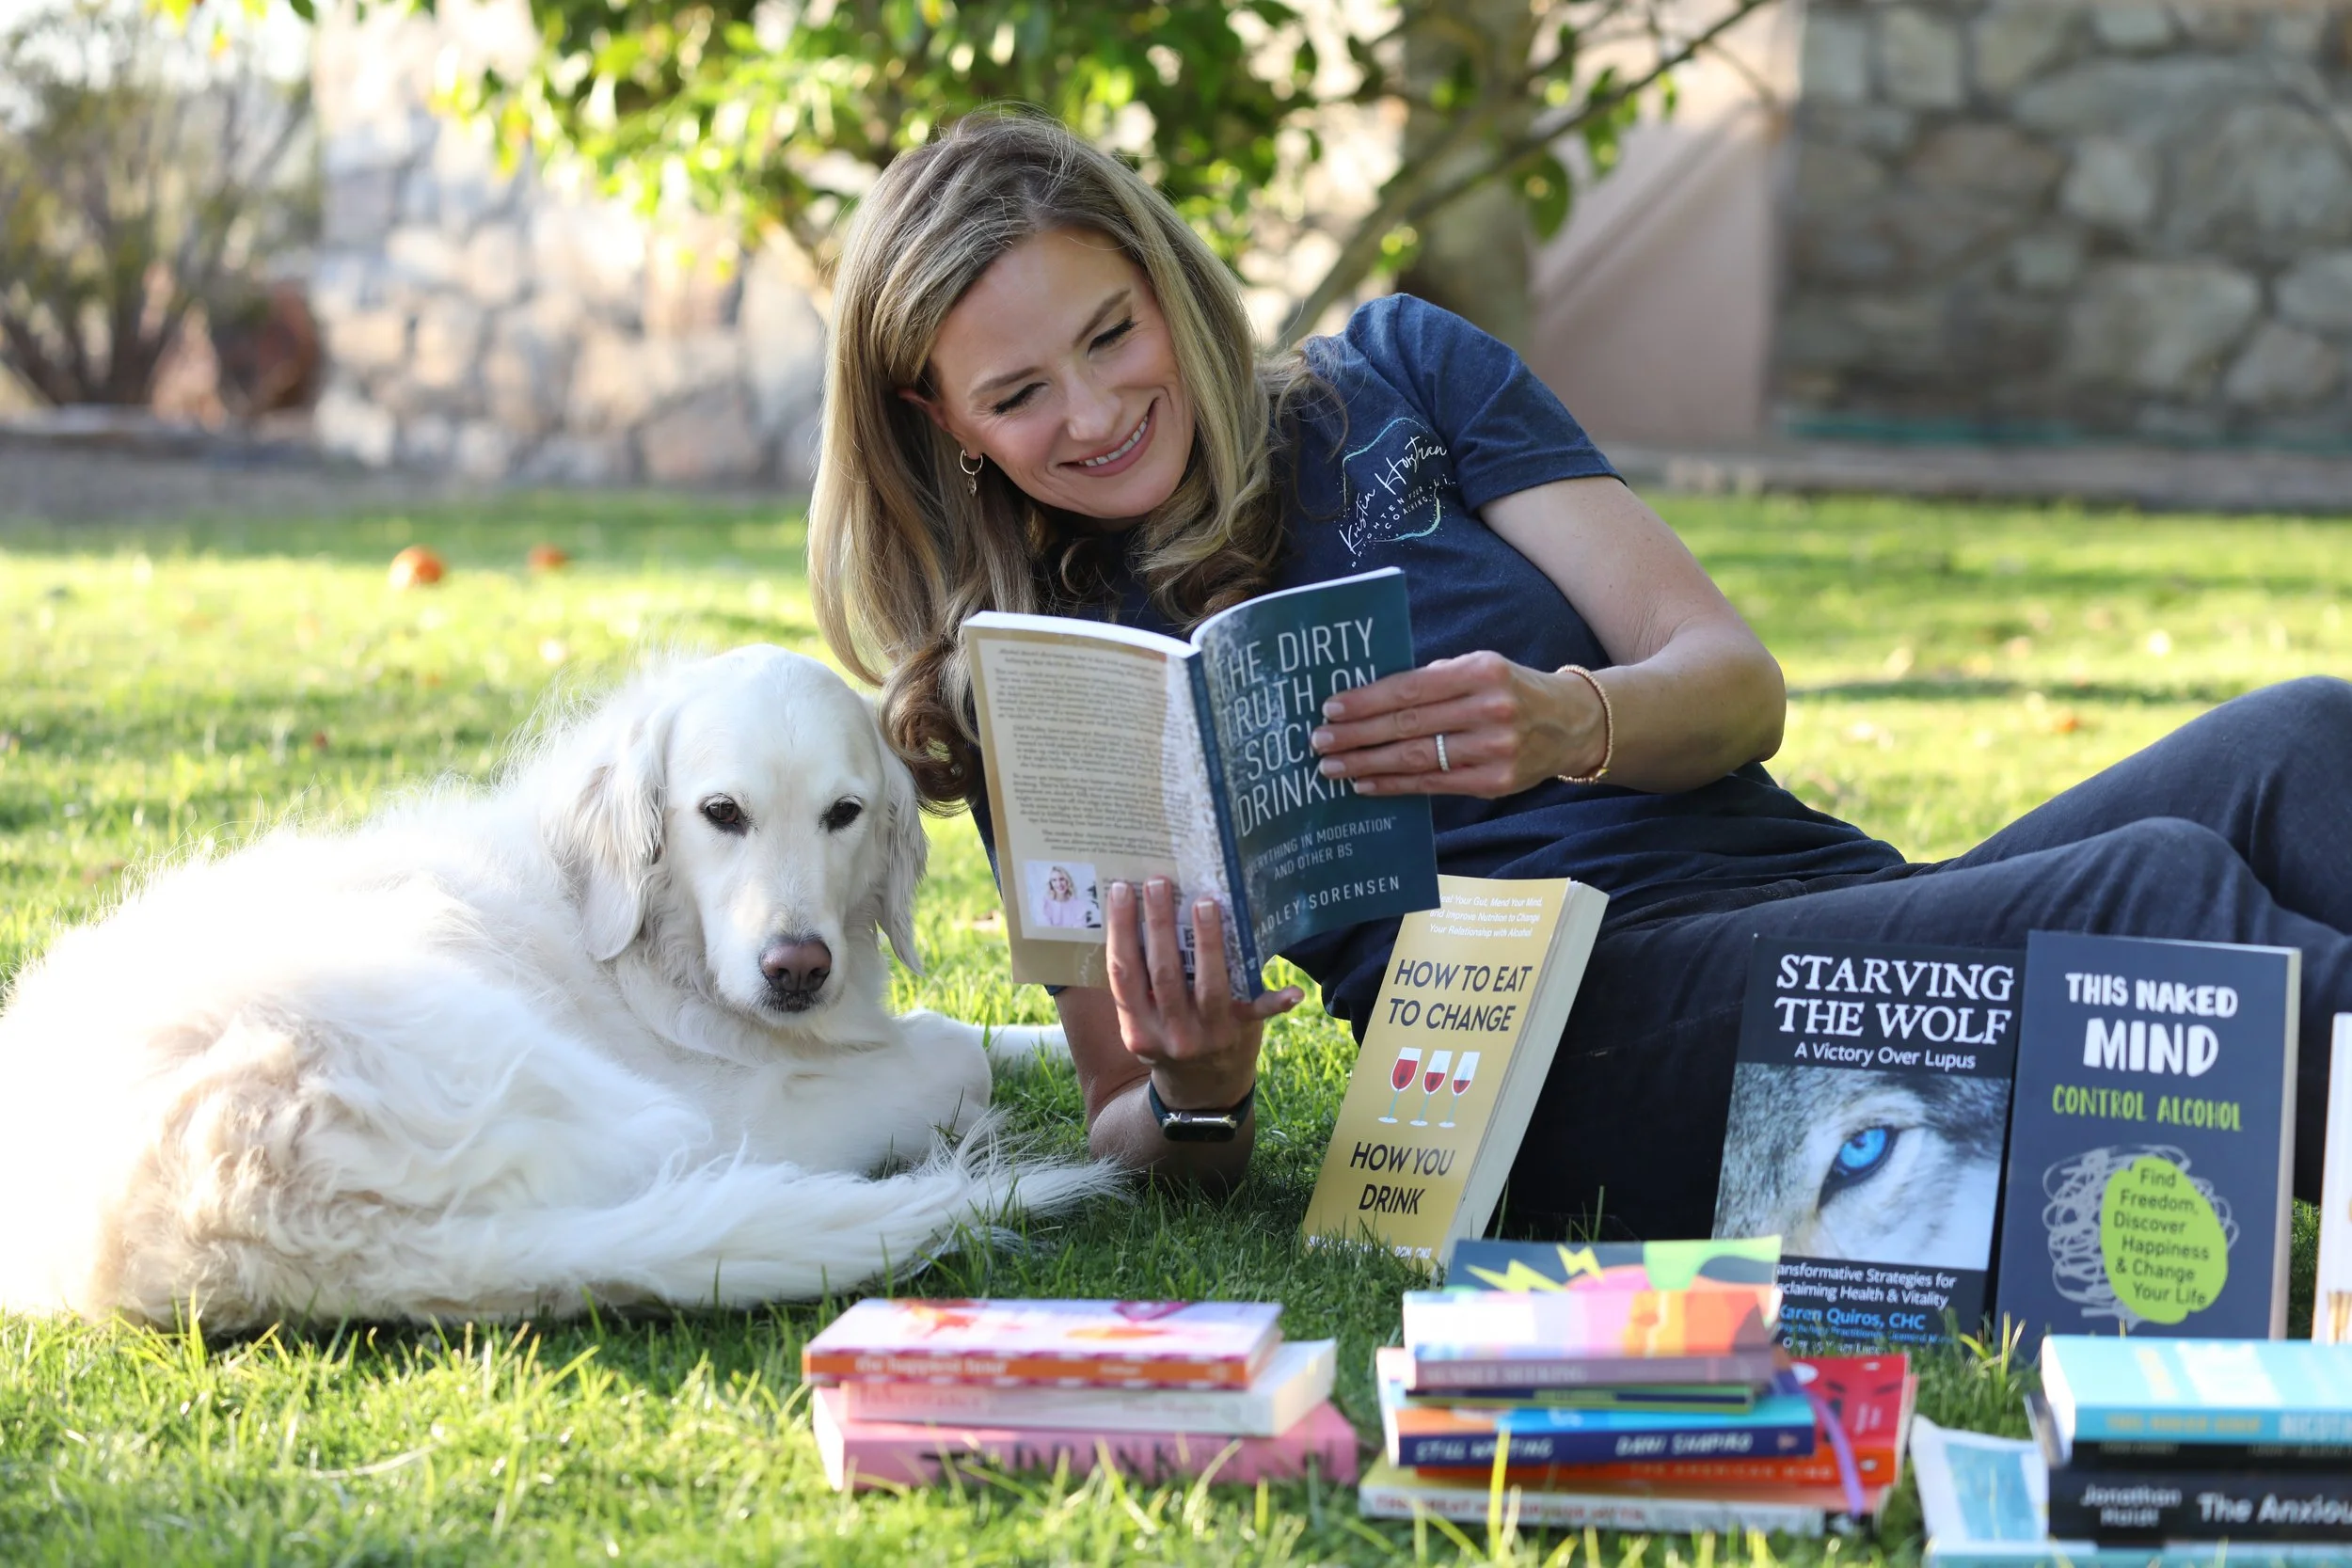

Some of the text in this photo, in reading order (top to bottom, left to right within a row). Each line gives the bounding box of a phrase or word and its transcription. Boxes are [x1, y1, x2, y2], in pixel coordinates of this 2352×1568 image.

[1338, 488, 1375, 555] Kristin
[1216, 641, 1263, 696] THE
[1278, 617, 1373, 673] DIRTY
[1223, 673, 1315, 747] TRUTH
[1244, 715, 1328, 782] SOCI
[1301, 832, 1313, 848] IN
[1274, 843, 1354, 881] AND OTHER BS
[1309, 876, 1400, 910] SORENSEN
[1455, 895, 1472, 905] Your
[1490, 896, 1511, 908] Mend
[1511, 897, 1525, 907] Your
[1429, 924, 1534, 939] Your Relationship with Alcohol
[1430, 909, 1540, 925] and Improve Nutrition to Change
[1393, 958, 1533, 992] HOW TO EAT
[1775, 953, 2014, 1002] STARVING
[2065, 973, 2238, 1018] THIS NAKED
[1388, 998, 1517, 1032] TO CHANGE
[1774, 996, 2012, 1045] THE WOLF
[1794, 1041, 1976, 1072] A Victory Over Lupus
[2083, 1017, 2219, 1077] MIND
[2052, 1084, 2243, 1132] CONTROL ALCOHOL
[1349, 1141, 1456, 1176] HOW YOU
[2139, 1167, 2177, 1188] Find
[1359, 1183, 1426, 1215] DRINK
[2120, 1189, 2199, 1215] Freedom,
[2113, 1210, 2186, 1234] Discover
[2122, 1235, 2210, 1262] Happiness
[1776, 1261, 1958, 1290] ansformative Strategies for
[2115, 1257, 2196, 1283] & Change
[1776, 1280, 1949, 1310] claiming Health & Vitality
[2133, 1281, 2207, 1305] Your Life
[1826, 1307, 1885, 1329] Quiros,
[1889, 1311, 1927, 1331] CHC
[2080, 1483, 2182, 1507] Jonathan
[2197, 1491, 2253, 1523] The
